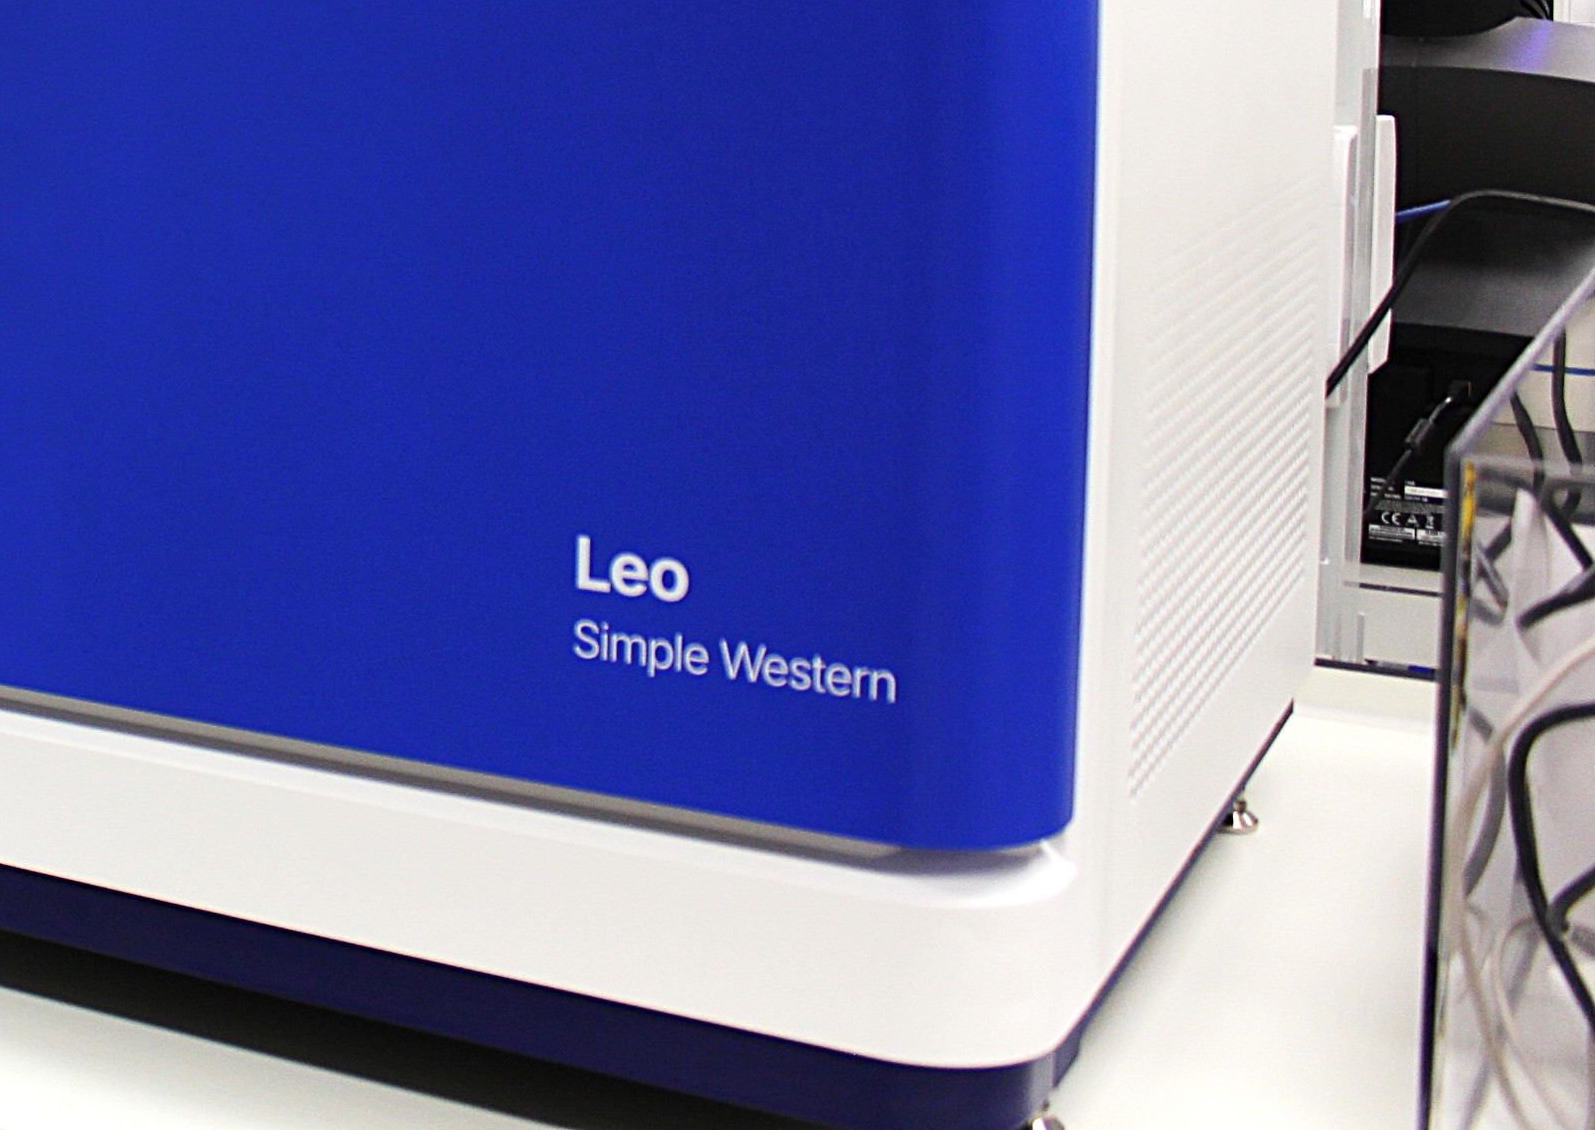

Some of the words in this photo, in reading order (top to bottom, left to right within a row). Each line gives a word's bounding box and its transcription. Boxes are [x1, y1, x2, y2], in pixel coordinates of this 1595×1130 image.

[575, 534, 690, 603] Leo
[572, 618, 711, 679] Simple
[719, 636, 898, 704] Western
